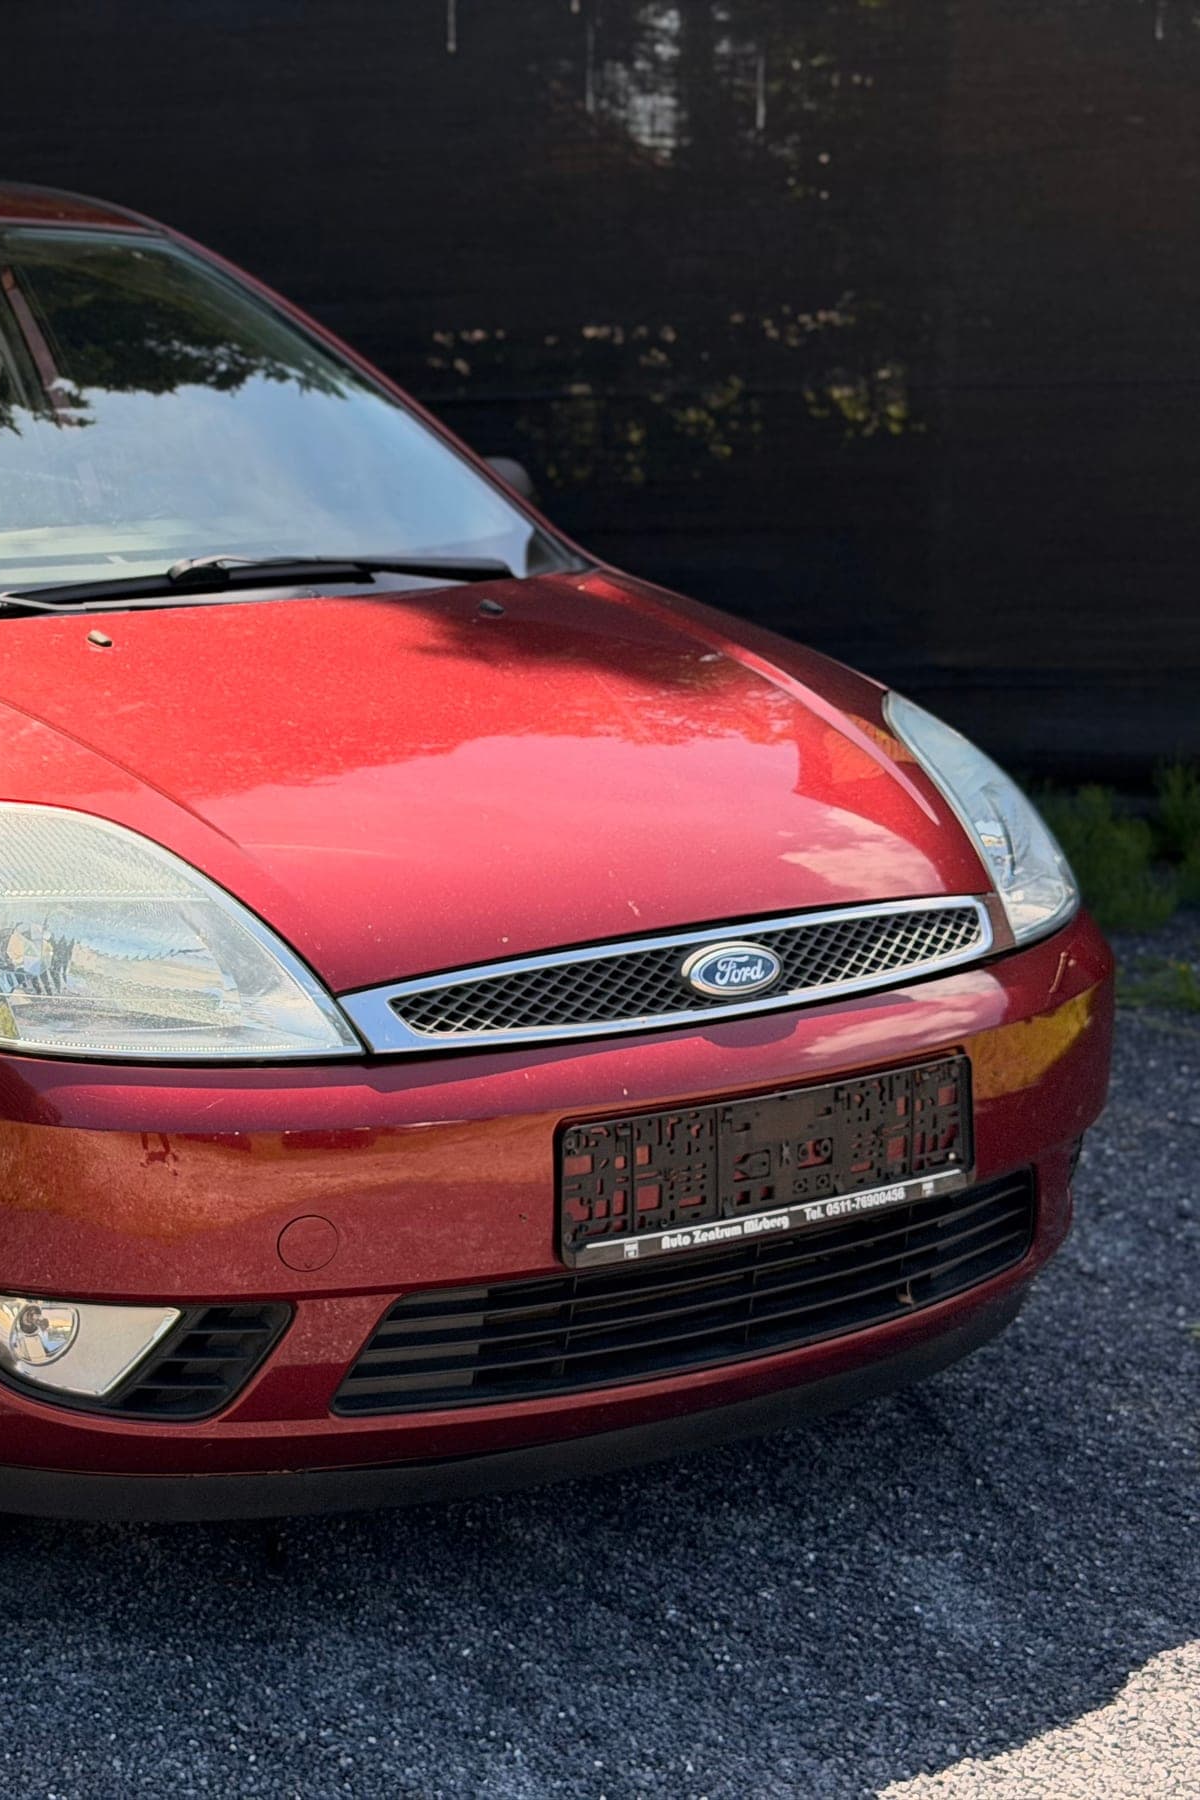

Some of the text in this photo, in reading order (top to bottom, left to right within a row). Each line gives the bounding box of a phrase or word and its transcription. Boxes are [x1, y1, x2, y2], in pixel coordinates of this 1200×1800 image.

[715, 955, 765, 986] Ford
[661, 1234, 691, 1250] Auto
[692, 1225, 743, 1244] Zentrum
[804, 1207, 825, 1221] Tel.
